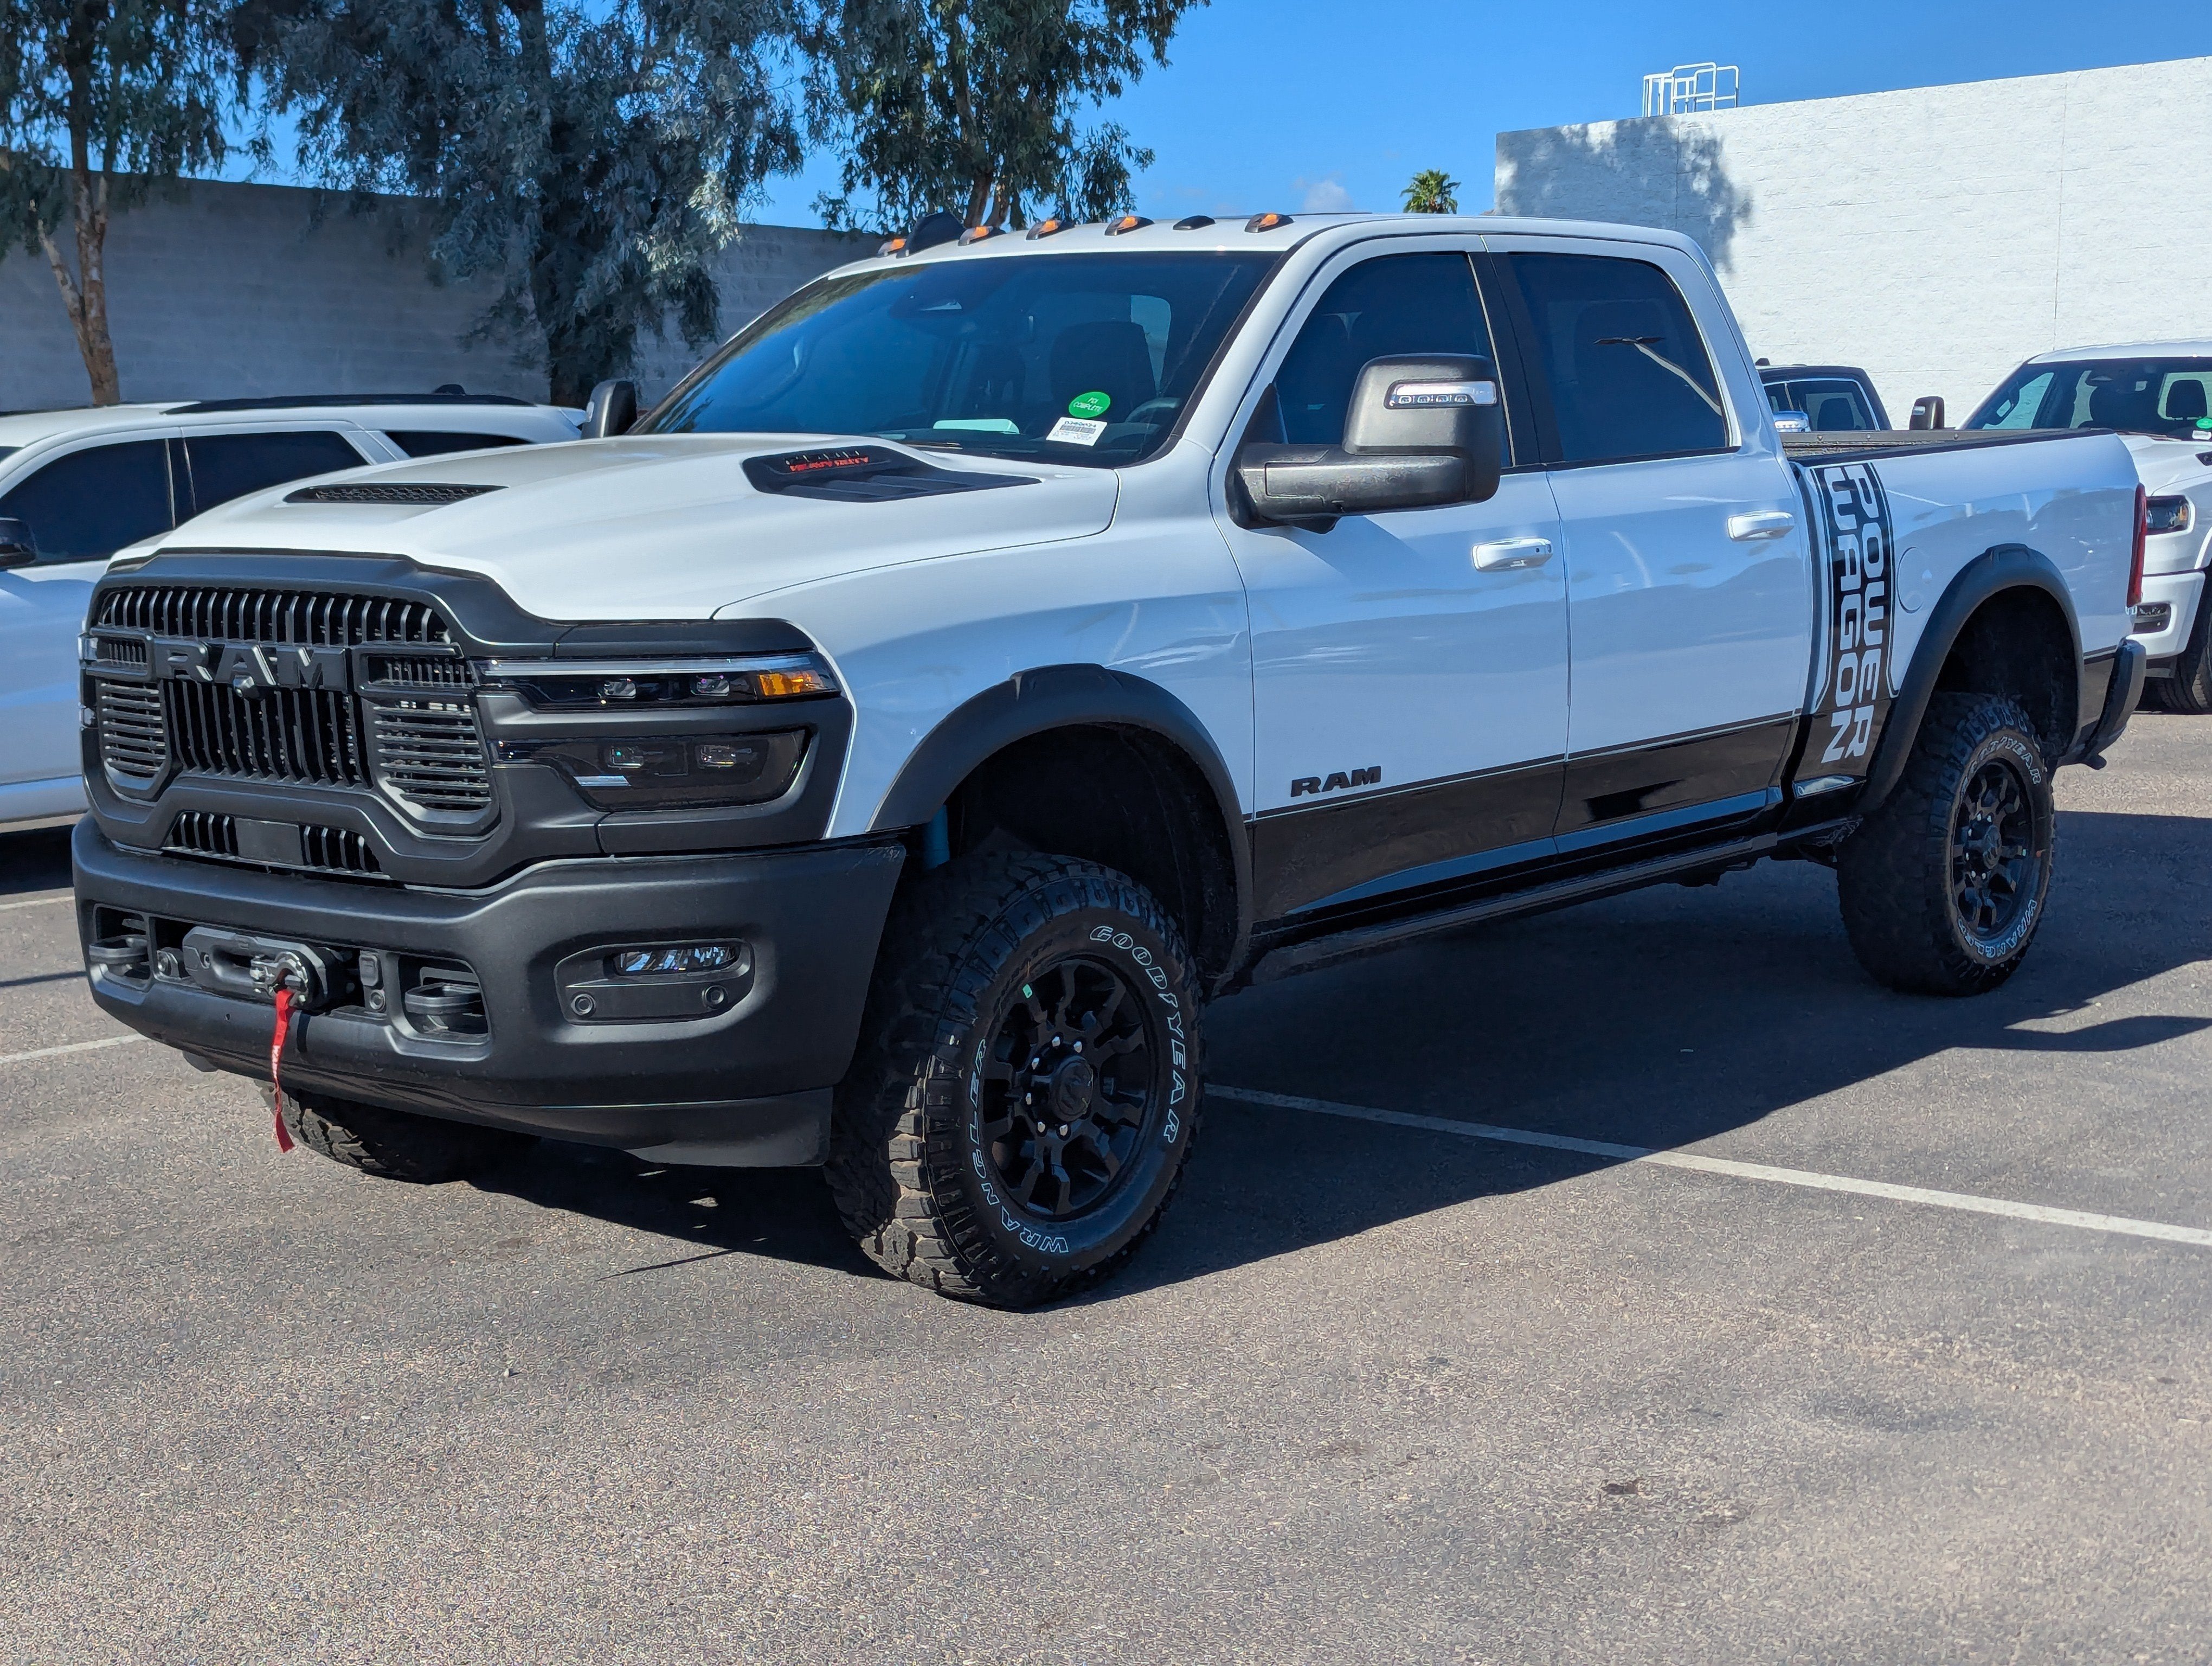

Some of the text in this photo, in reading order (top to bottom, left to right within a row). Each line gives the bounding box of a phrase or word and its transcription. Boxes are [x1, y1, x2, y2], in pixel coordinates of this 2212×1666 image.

[155, 639, 347, 690] RAM
[1821, 466, 1861, 764] WAGON
[1845, 464, 1886, 759] POWER
[1290, 765, 1381, 798] RAM
[1089, 925, 1187, 1143] GOODYEAR
[969, 1038, 1069, 1253] WRANGLER
